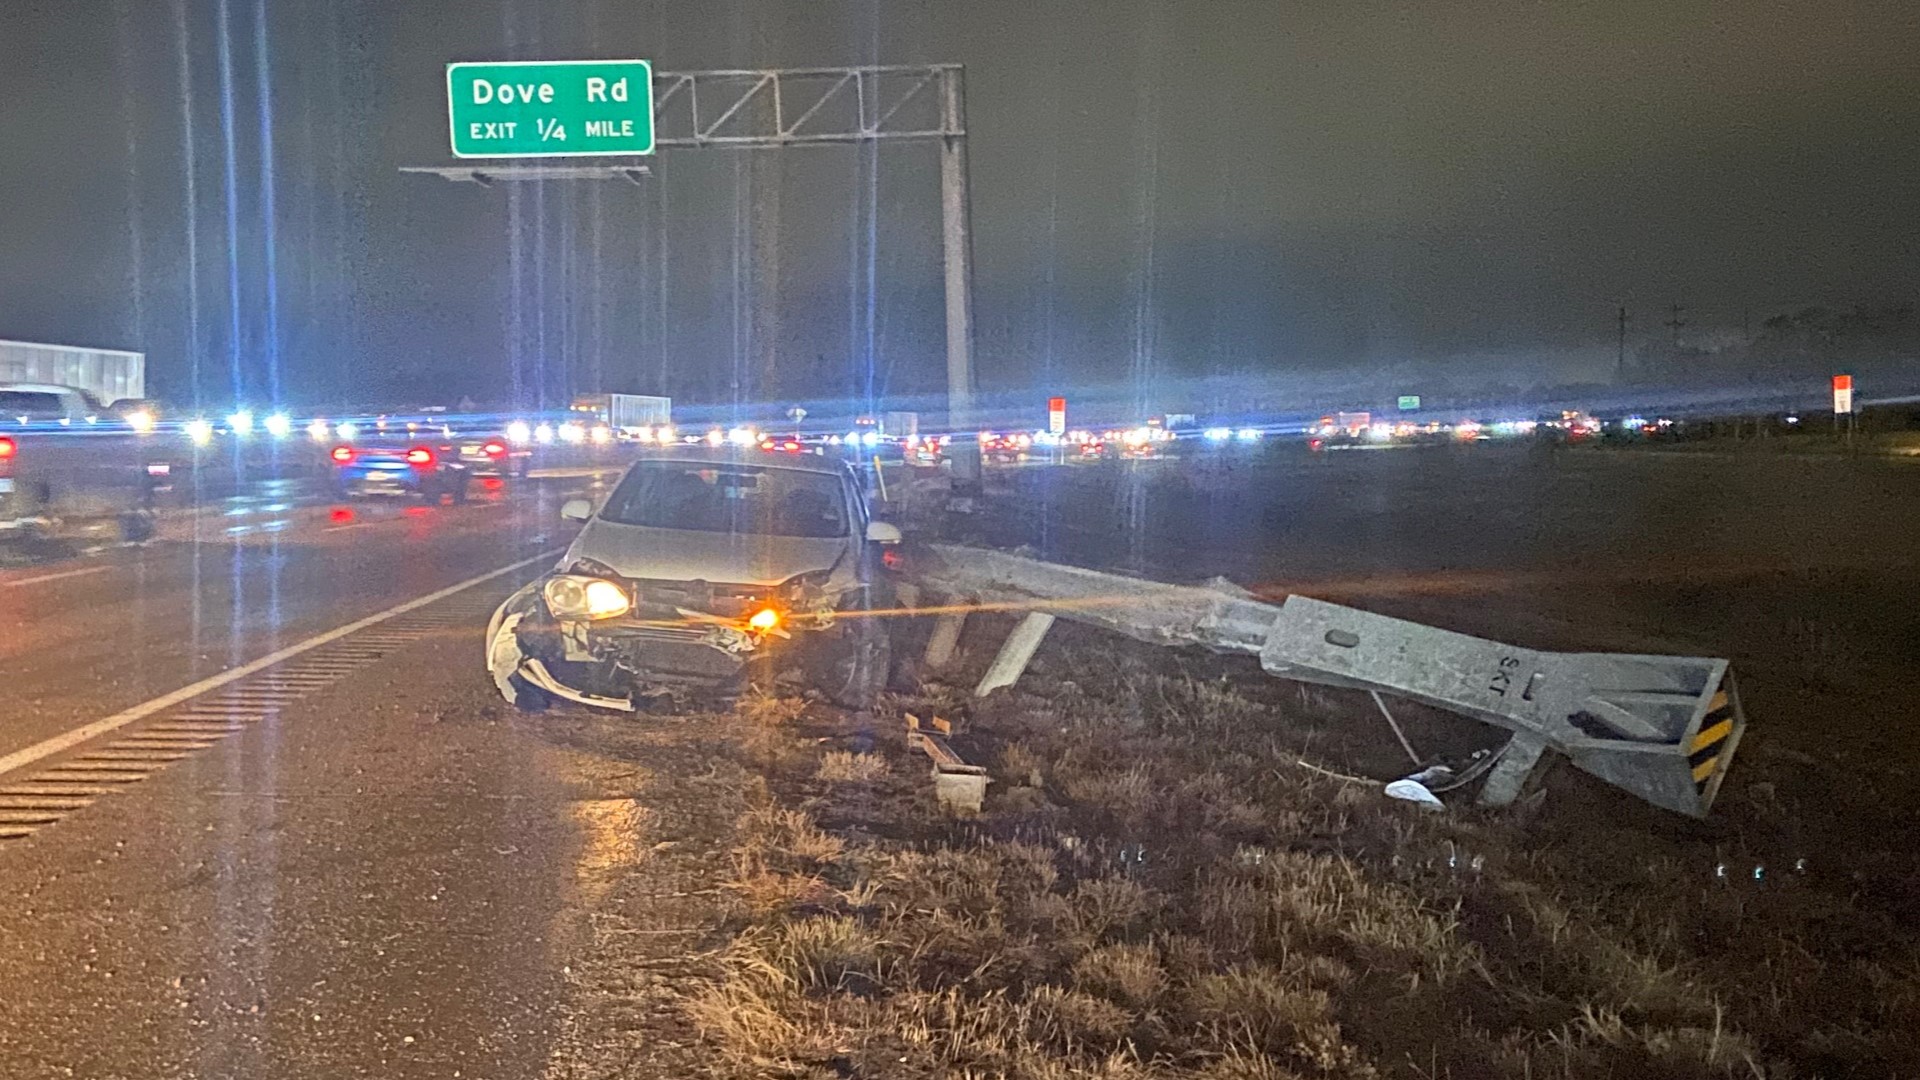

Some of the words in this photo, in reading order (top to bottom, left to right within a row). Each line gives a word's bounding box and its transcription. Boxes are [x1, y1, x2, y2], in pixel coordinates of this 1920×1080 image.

[472, 79, 555, 104] Dove
[586, 77, 629, 102] Rd
[470, 122, 517, 139] EXIT
[585, 120, 634, 137] MILE
[1488, 656, 1520, 697] SKT
